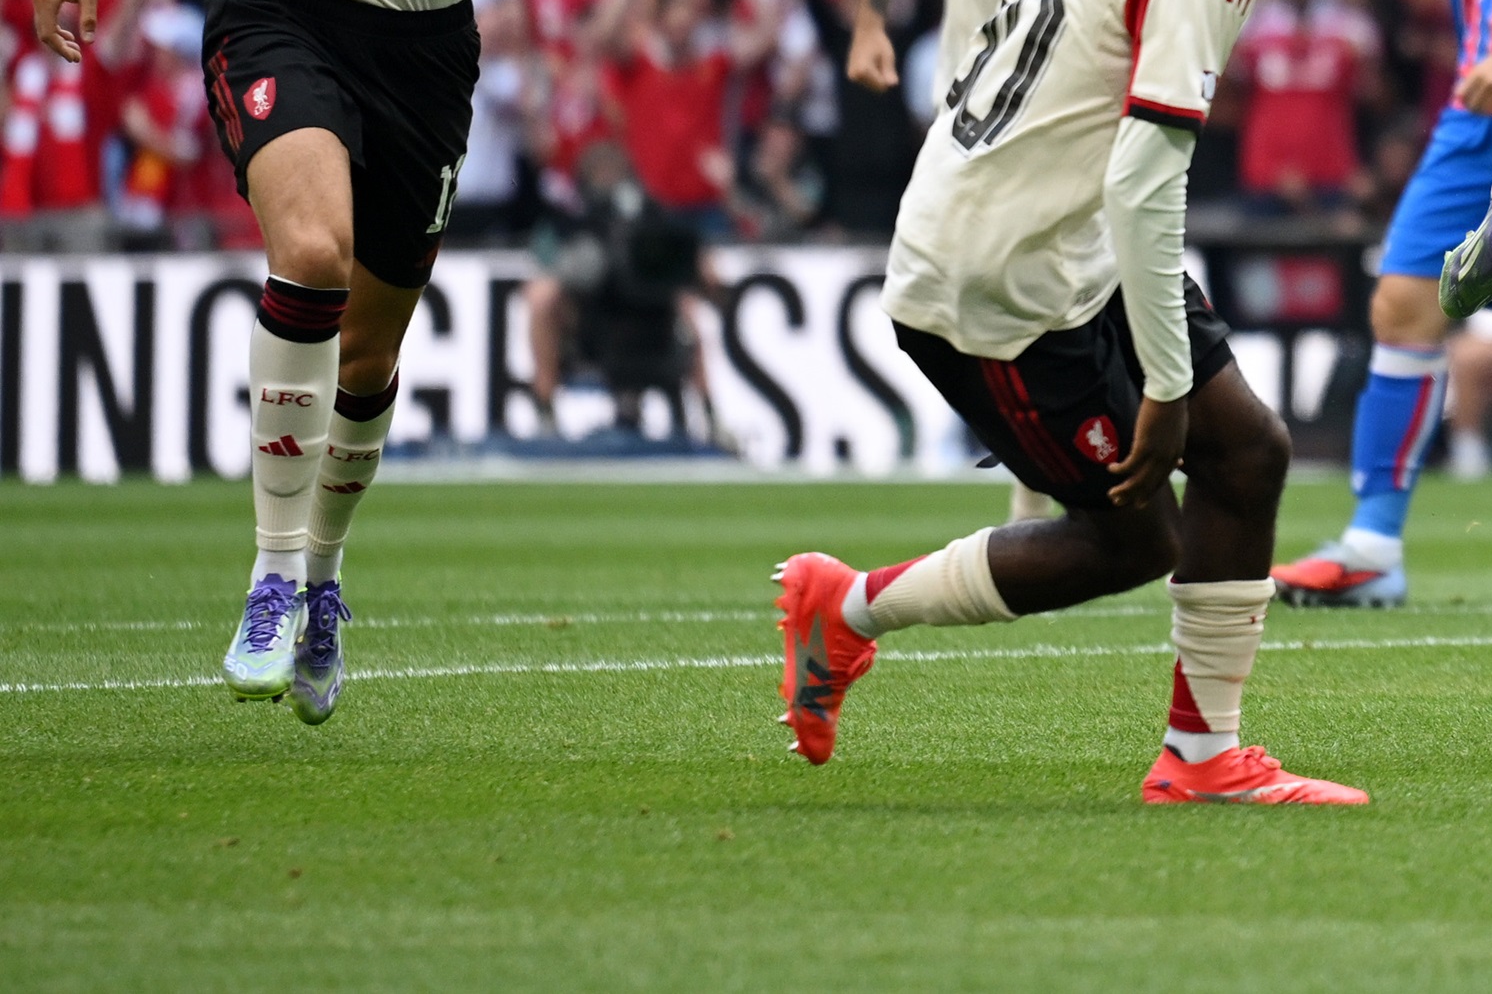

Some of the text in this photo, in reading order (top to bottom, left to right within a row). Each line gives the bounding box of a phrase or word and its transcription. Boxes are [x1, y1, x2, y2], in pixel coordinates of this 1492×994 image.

[426, 153, 467, 234] 1
[261, 387, 314, 408] LFC
[328, 443, 381, 463] LFC
